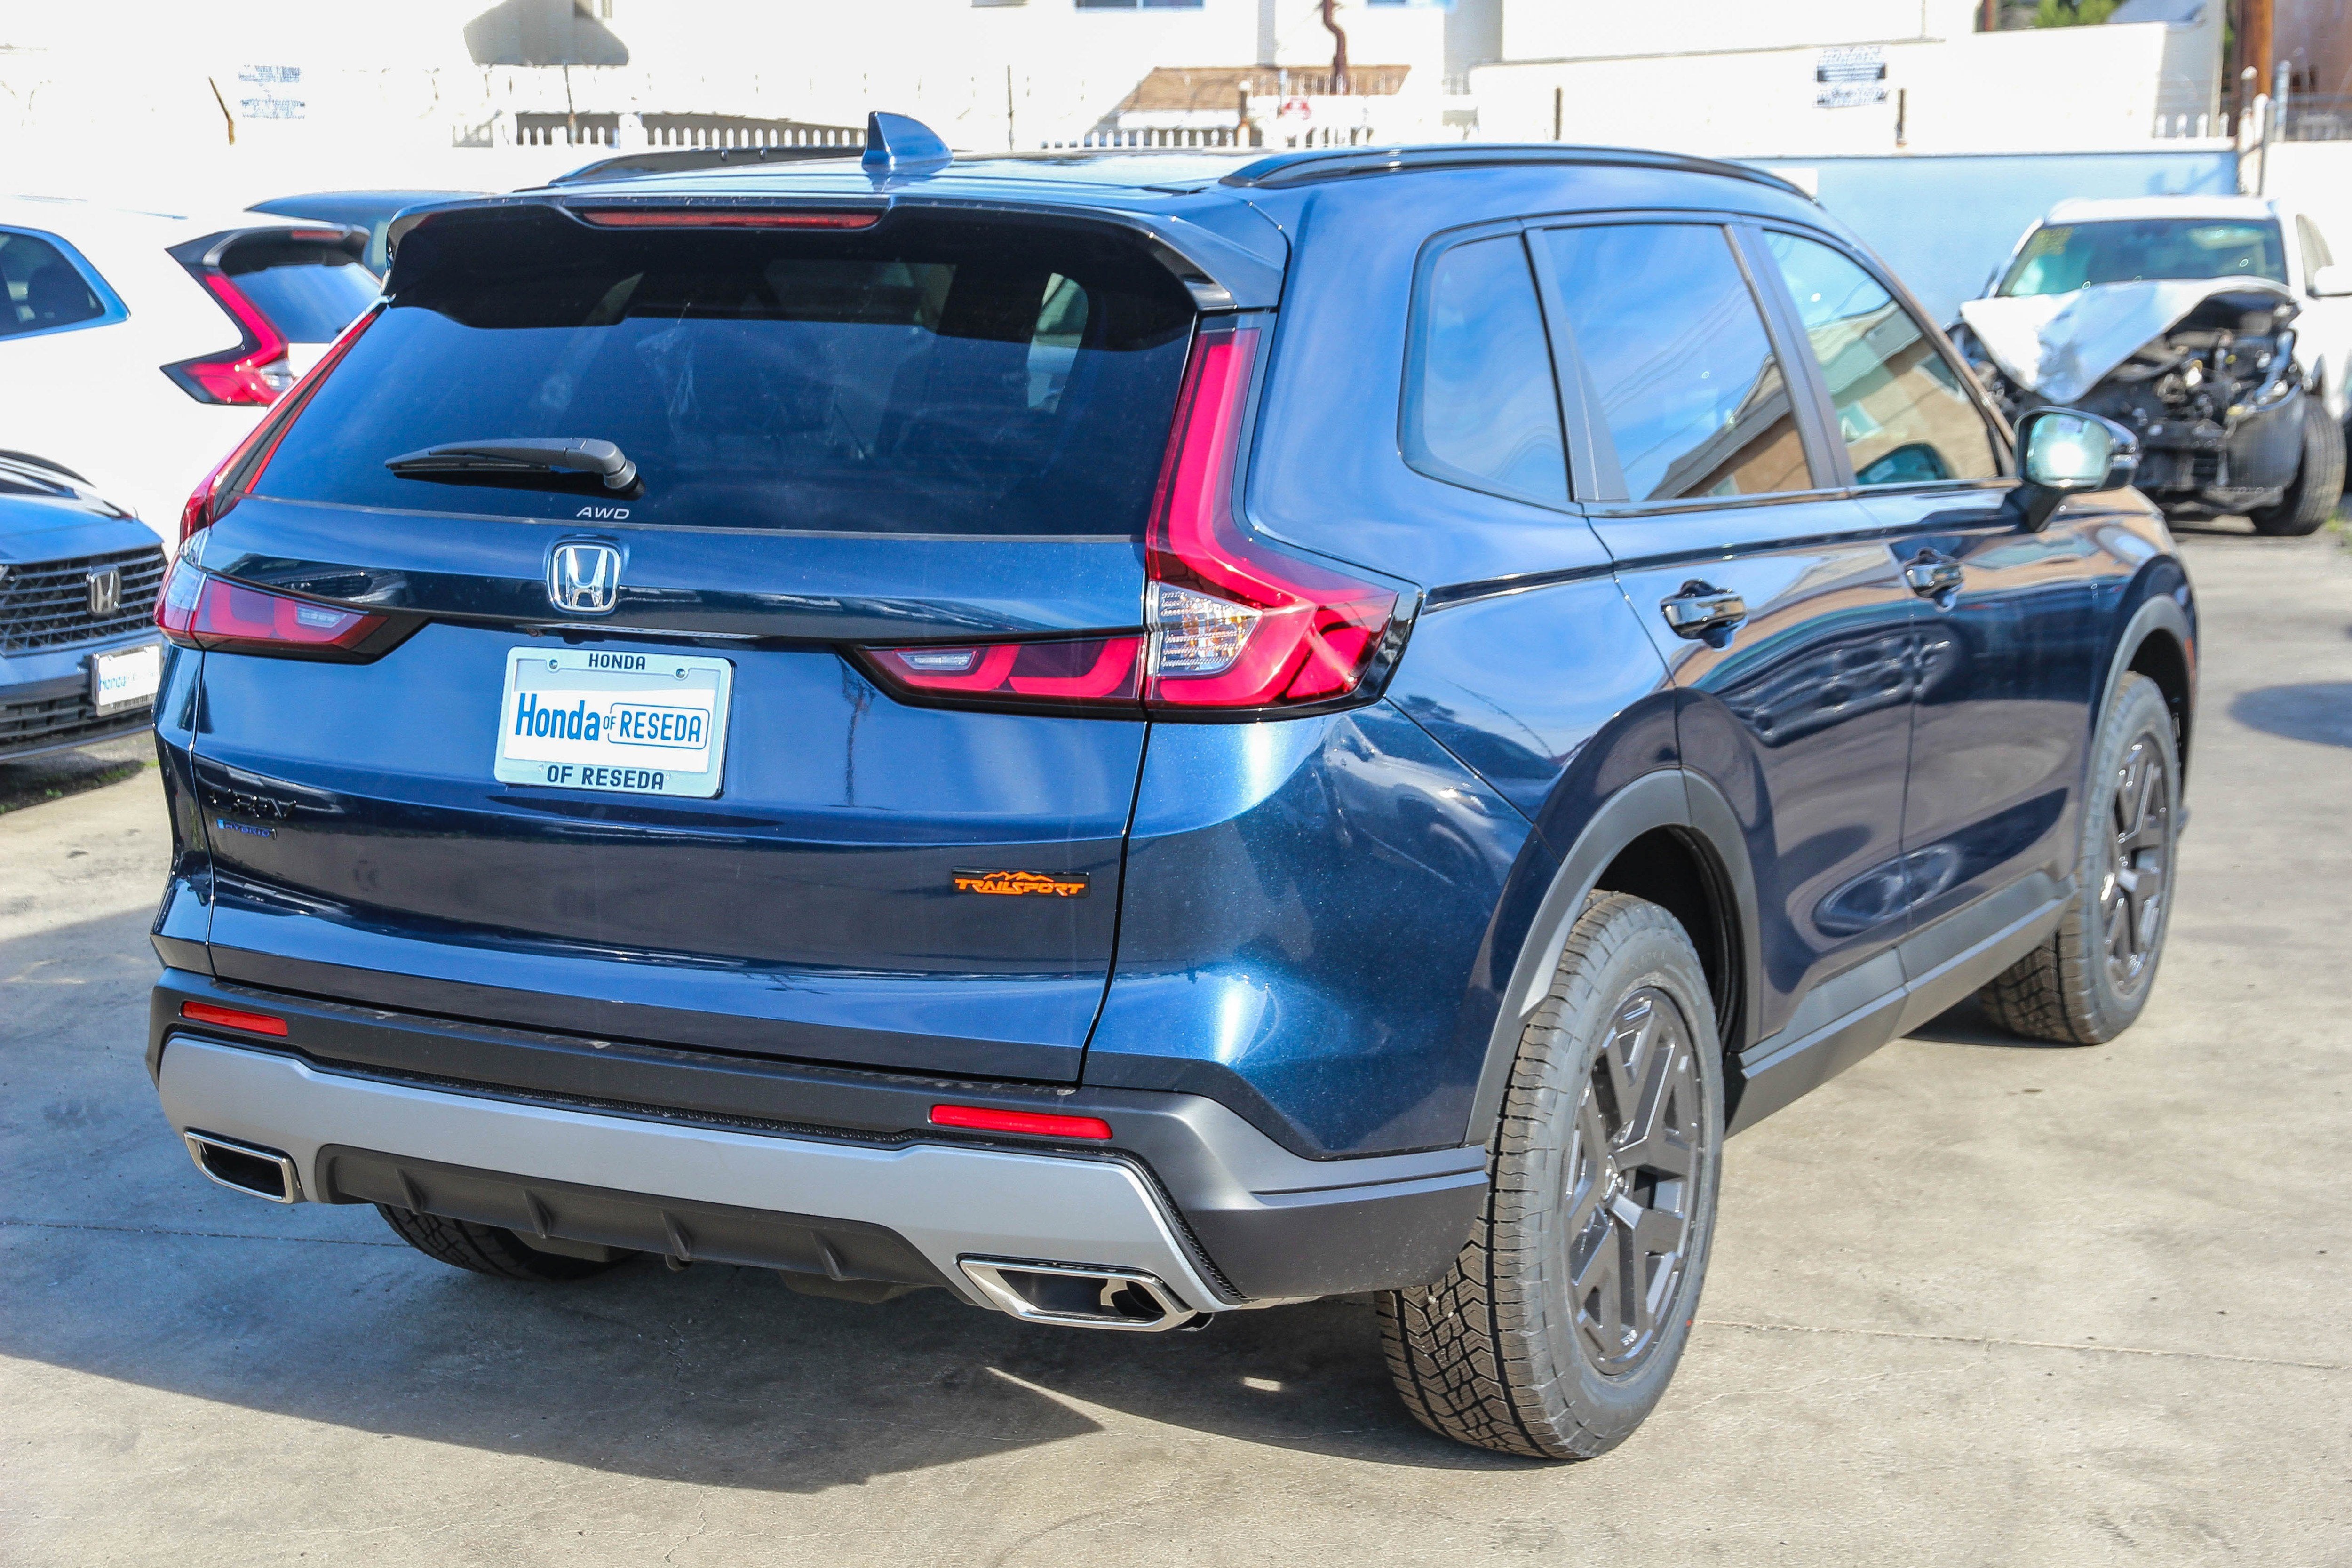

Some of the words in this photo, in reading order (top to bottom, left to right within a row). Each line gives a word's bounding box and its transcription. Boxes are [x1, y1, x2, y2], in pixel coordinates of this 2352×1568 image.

[576, 506, 630, 519] AWD
[588, 653, 646, 670] HONDA
[515, 693, 600, 741] Honda
[603, 716, 617, 730] OF
[620, 710, 701, 742] RESEDA
[547, 765, 573, 783] OF
[581, 767, 664, 790] RESEDA
[954, 878, 1085, 897] TRAILSPORT
